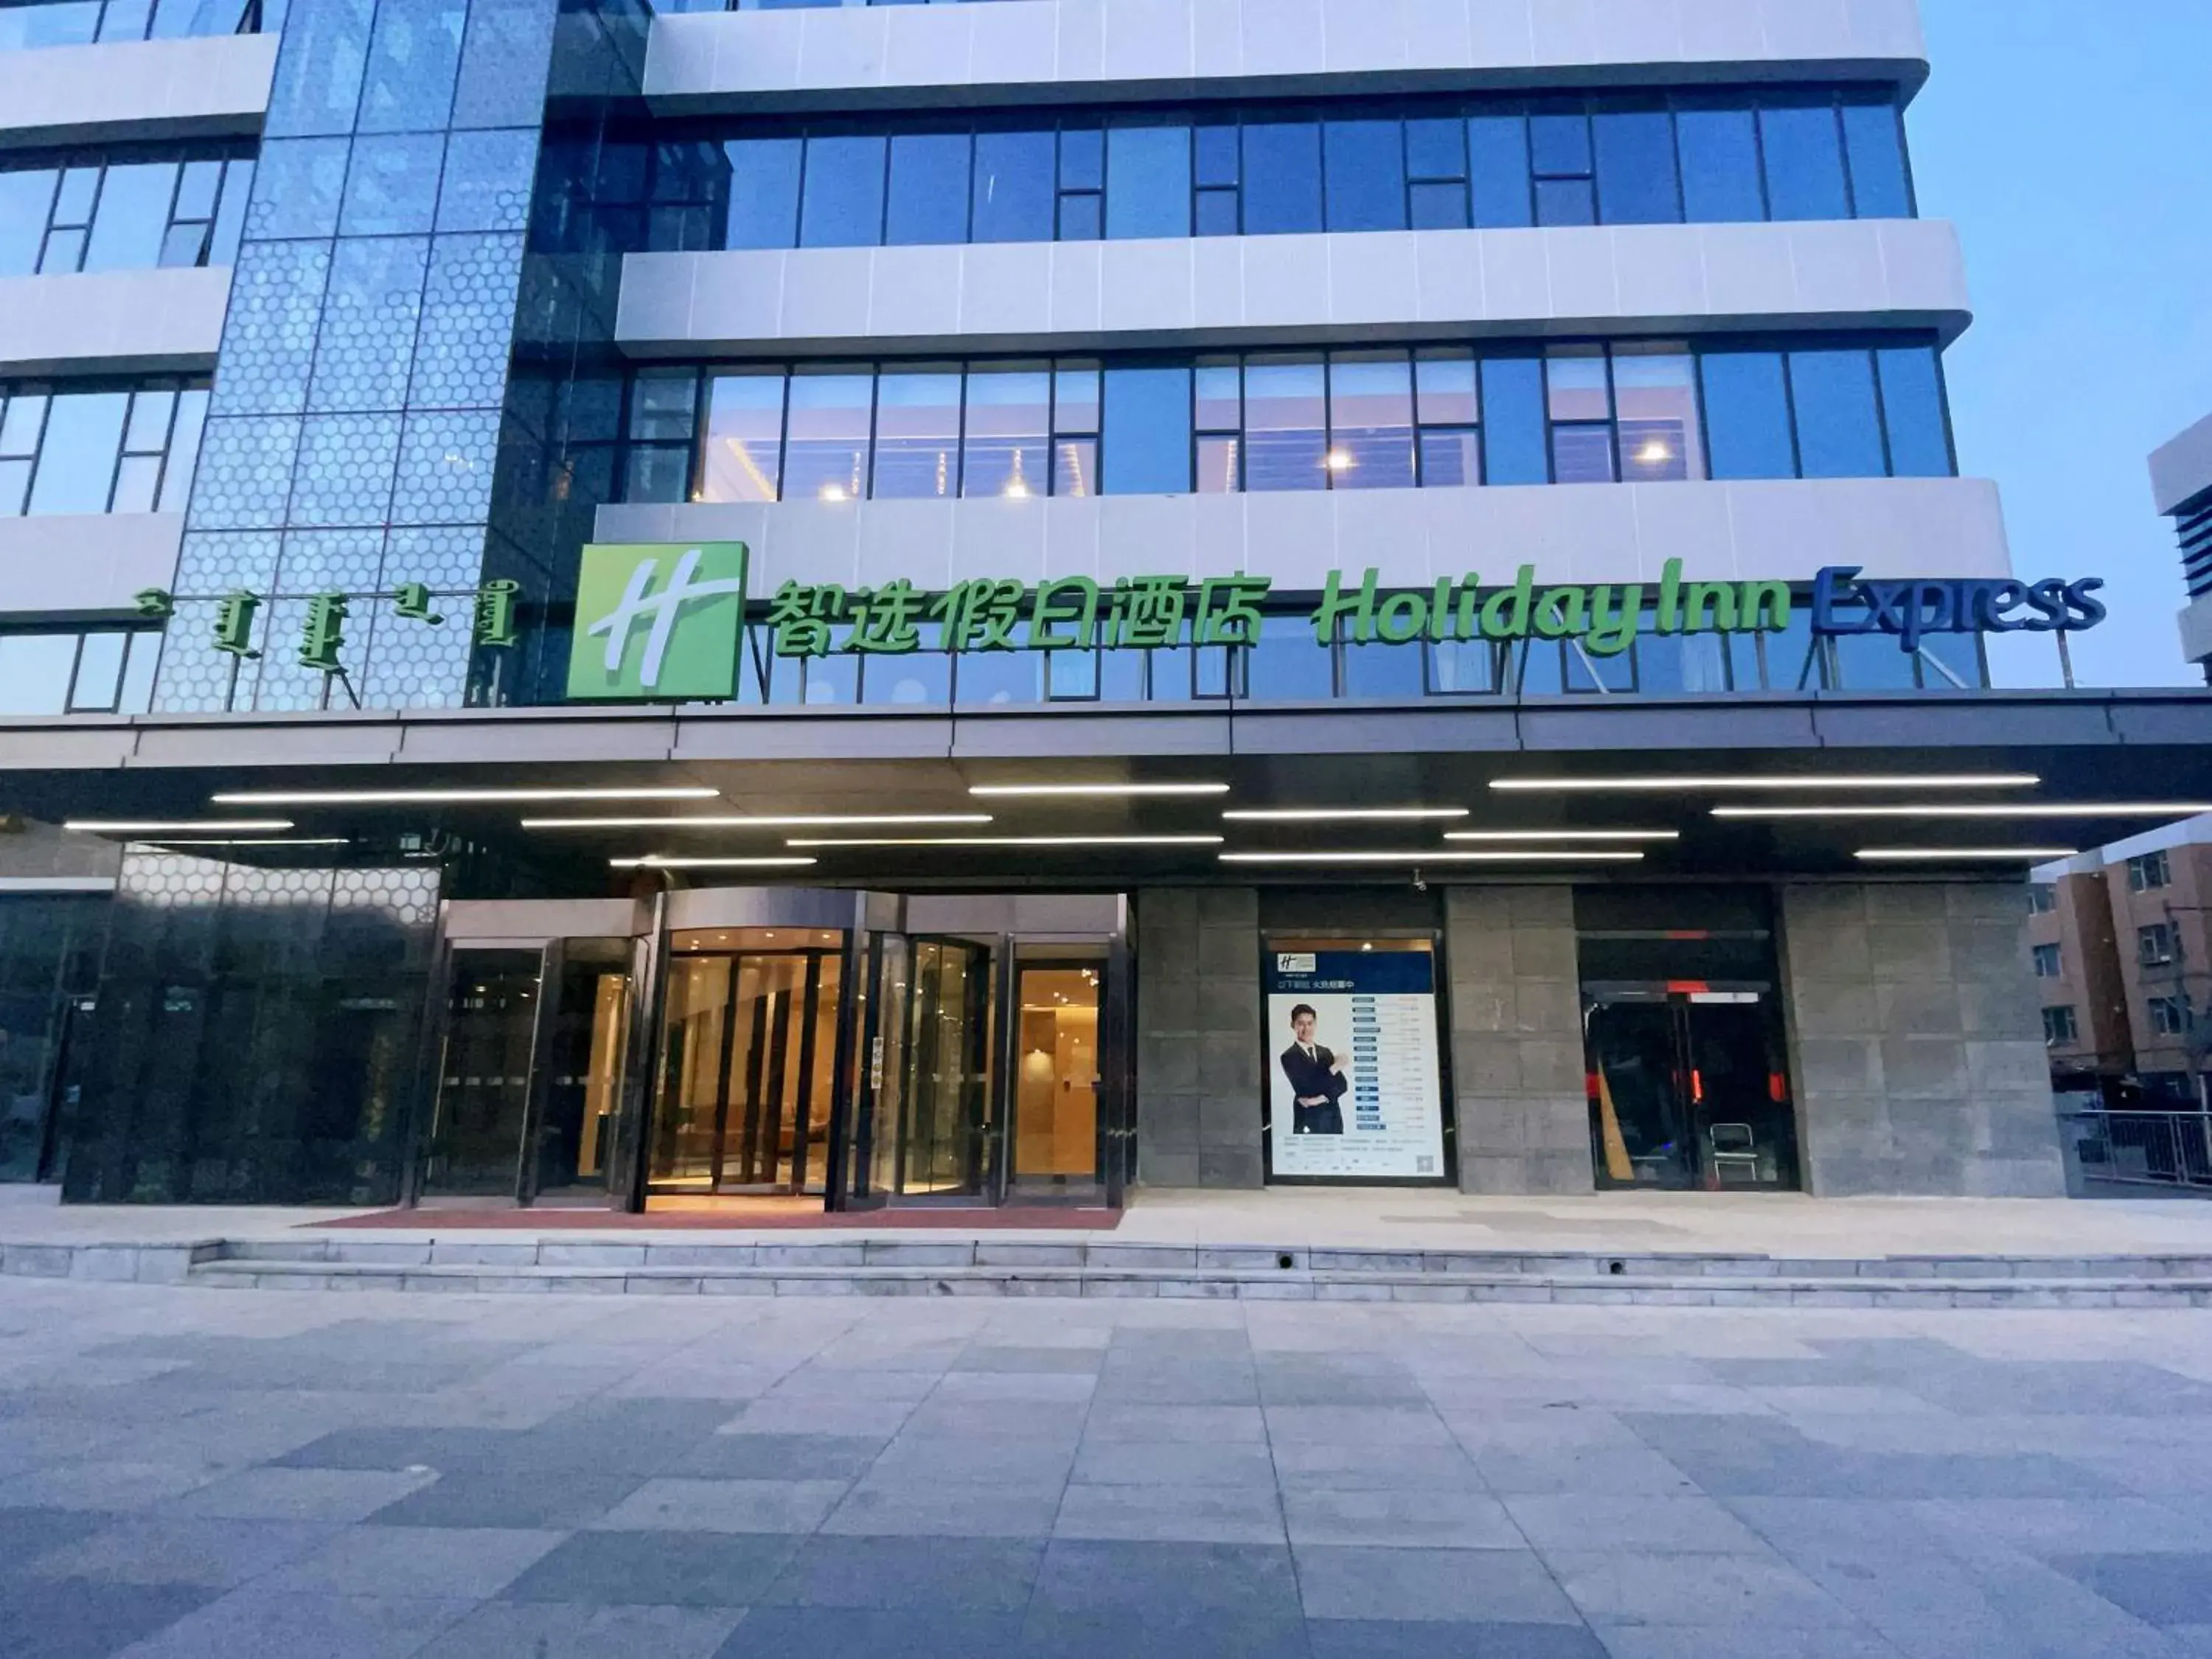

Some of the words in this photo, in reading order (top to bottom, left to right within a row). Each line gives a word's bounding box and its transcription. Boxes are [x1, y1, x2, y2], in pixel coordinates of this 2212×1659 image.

[588, 549, 740, 686] H
[766, 570, 1273, 657] 智选假日酒店
[1310, 564, 1643, 658] Holiday
[1656, 557, 1792, 636] Inn
[1811, 566, 2107, 653] Express
